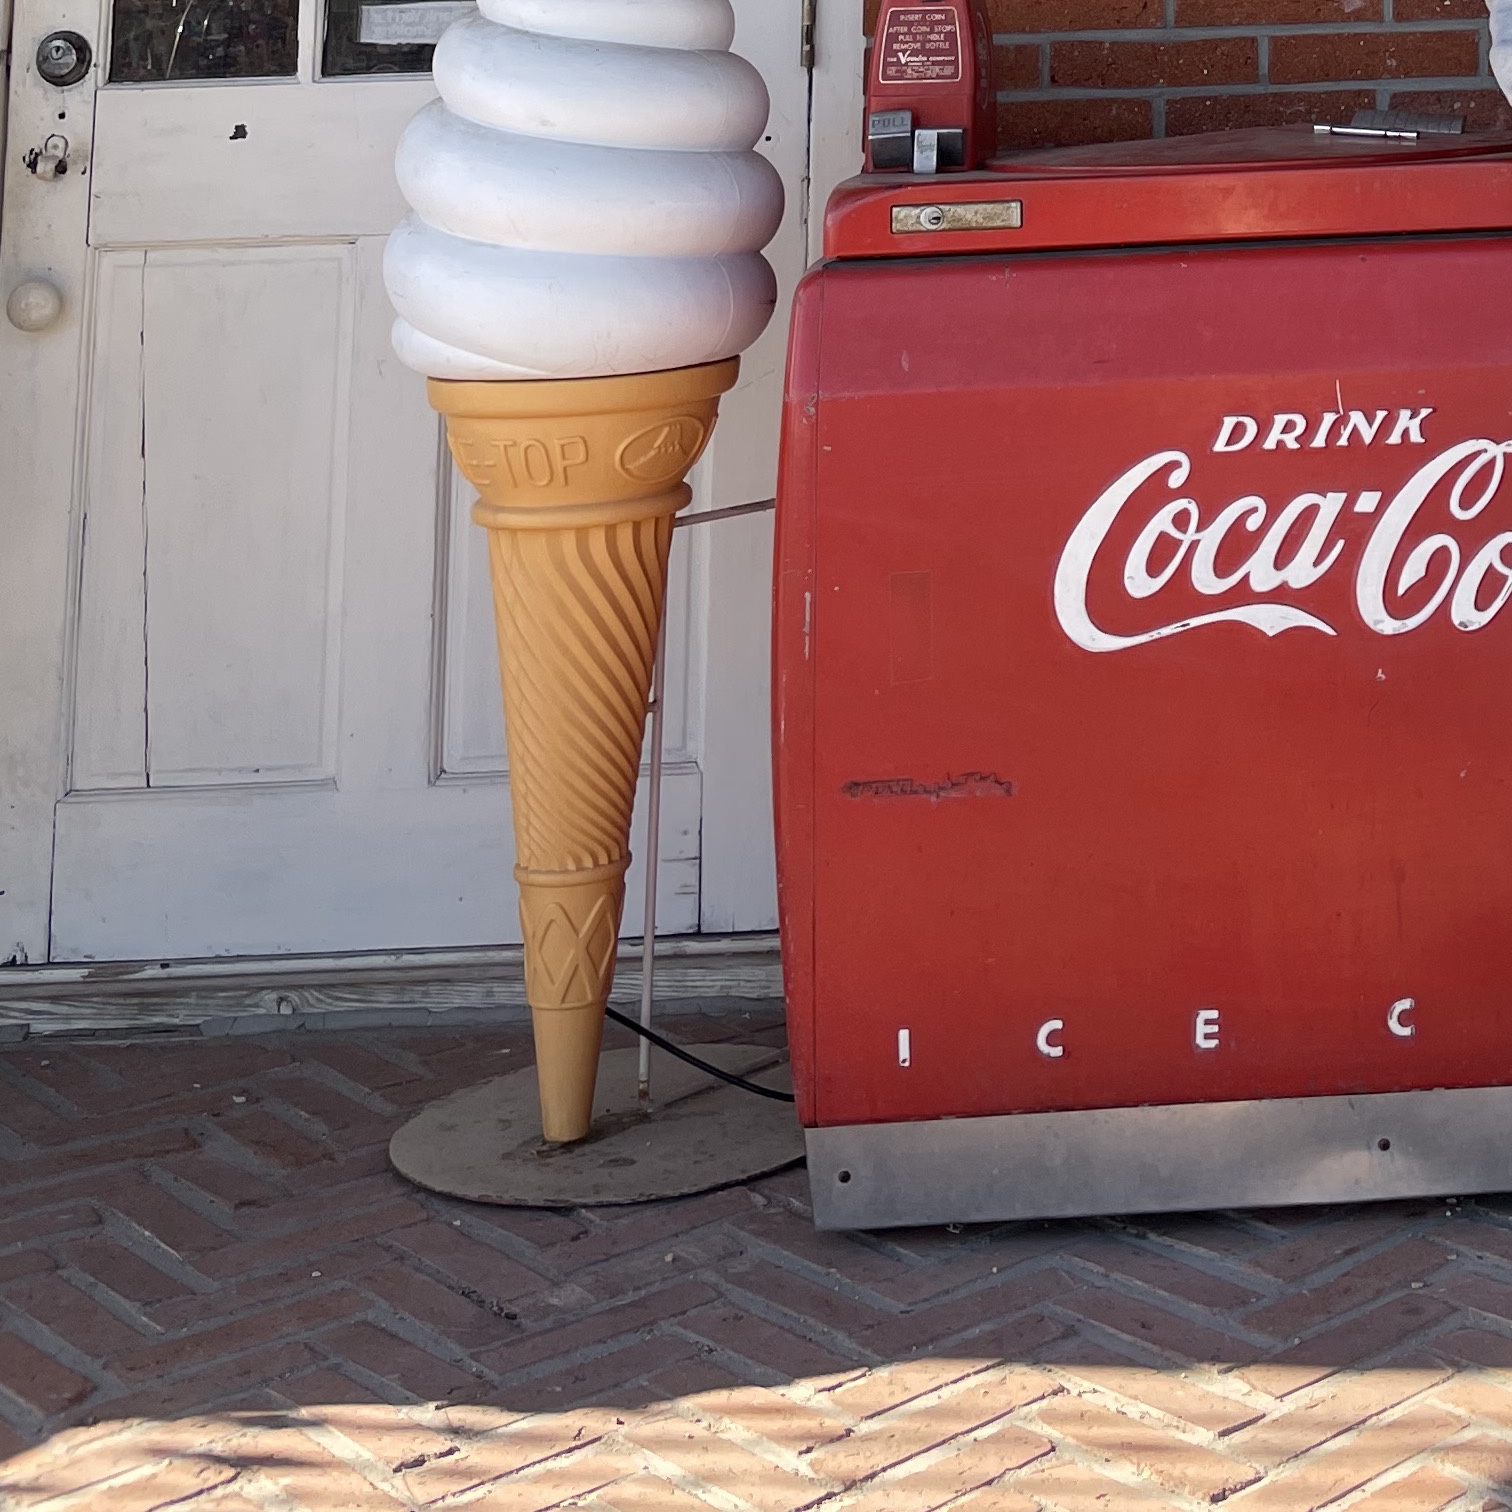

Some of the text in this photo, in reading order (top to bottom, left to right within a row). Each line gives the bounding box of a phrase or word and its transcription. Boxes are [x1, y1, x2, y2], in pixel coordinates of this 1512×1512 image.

[872, 116, 908, 128] PULL
[1212, 407, 1434, 452] DRINK
[898, 1008, 1220, 1067] ICE
